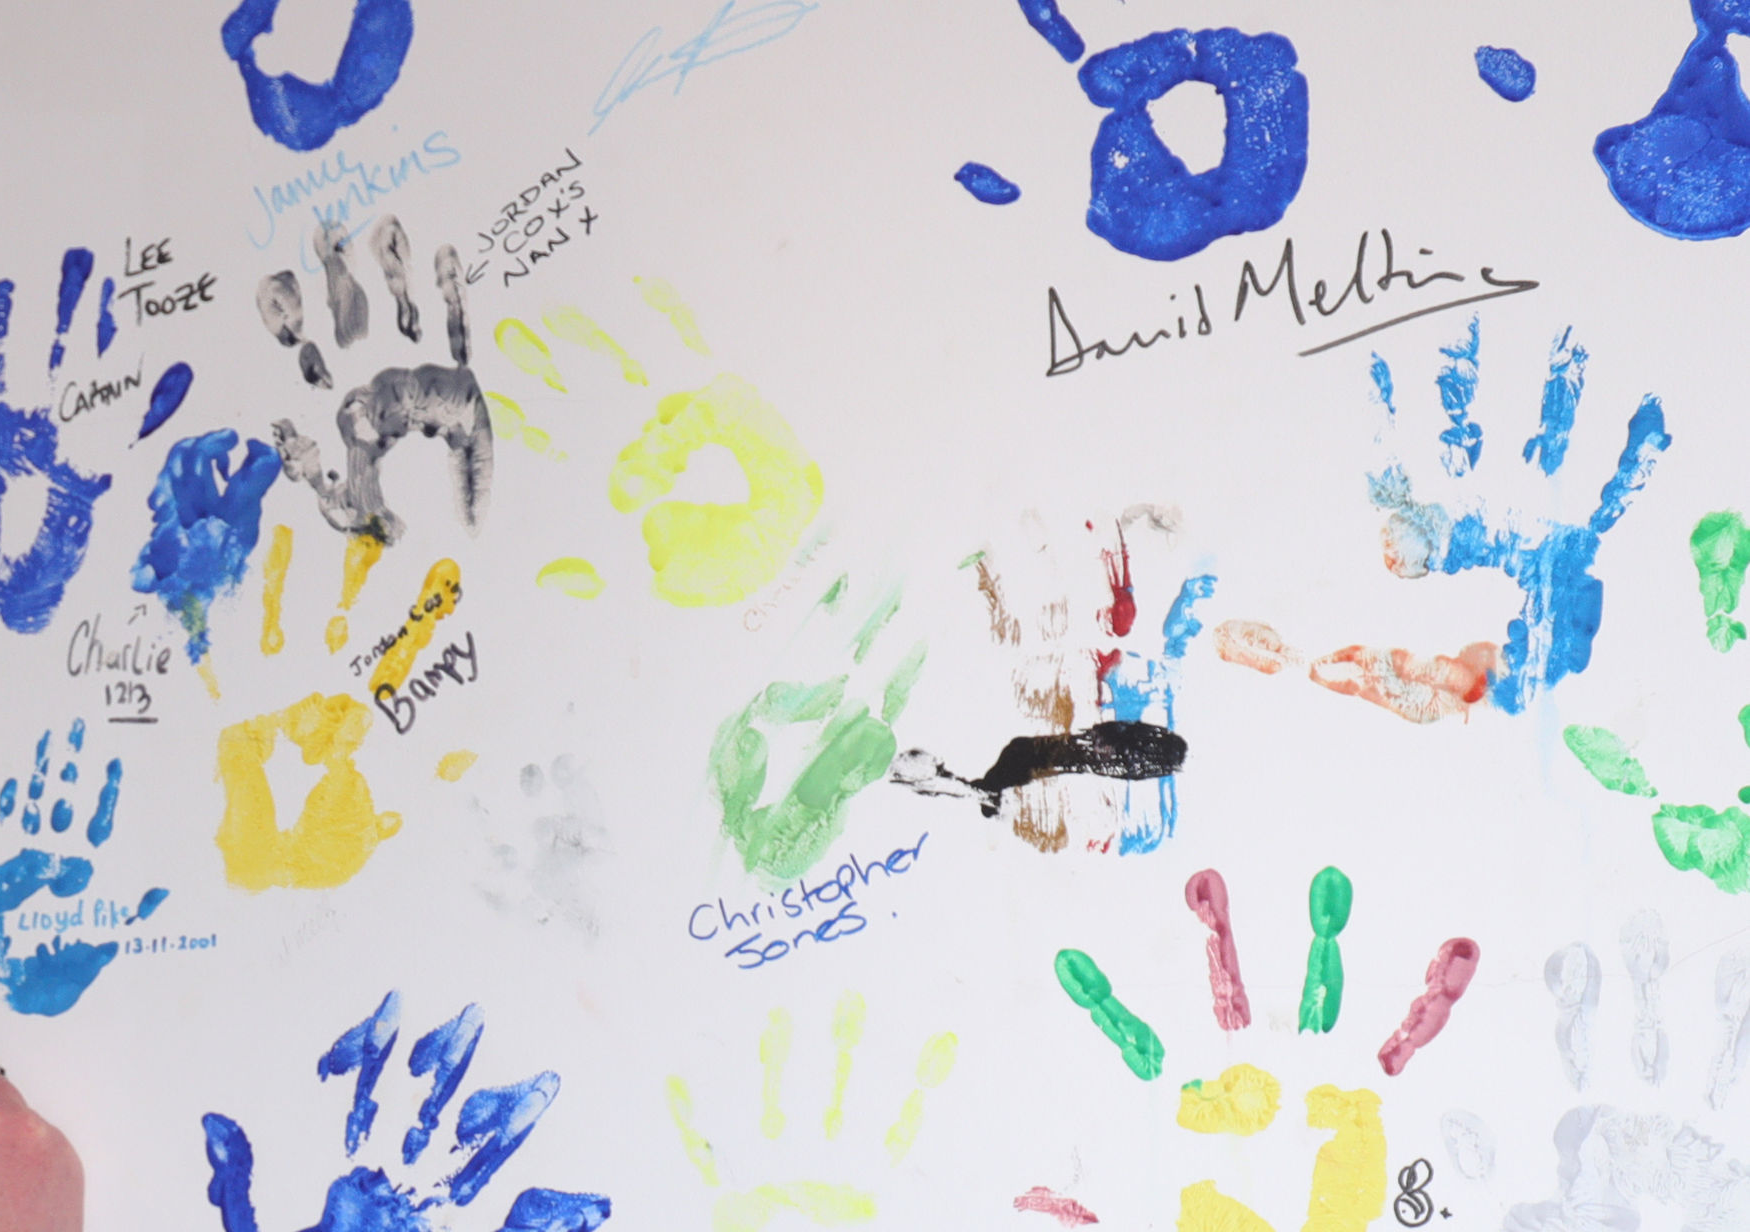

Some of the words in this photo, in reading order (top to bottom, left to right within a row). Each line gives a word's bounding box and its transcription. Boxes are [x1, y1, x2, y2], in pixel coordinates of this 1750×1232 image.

[478, 147, 583, 253] JORDAN
[502, 180, 585, 254] COX'S
[124, 236, 174, 278] LEE
[503, 227, 571, 289] NAN
[117, 272, 217, 326] TOOZE
[1046, 283, 1212, 377] David
[67, 612, 173, 678] Charlie
[17, 899, 84, 934] Lloyd
[688, 830, 931, 943] Christopher
